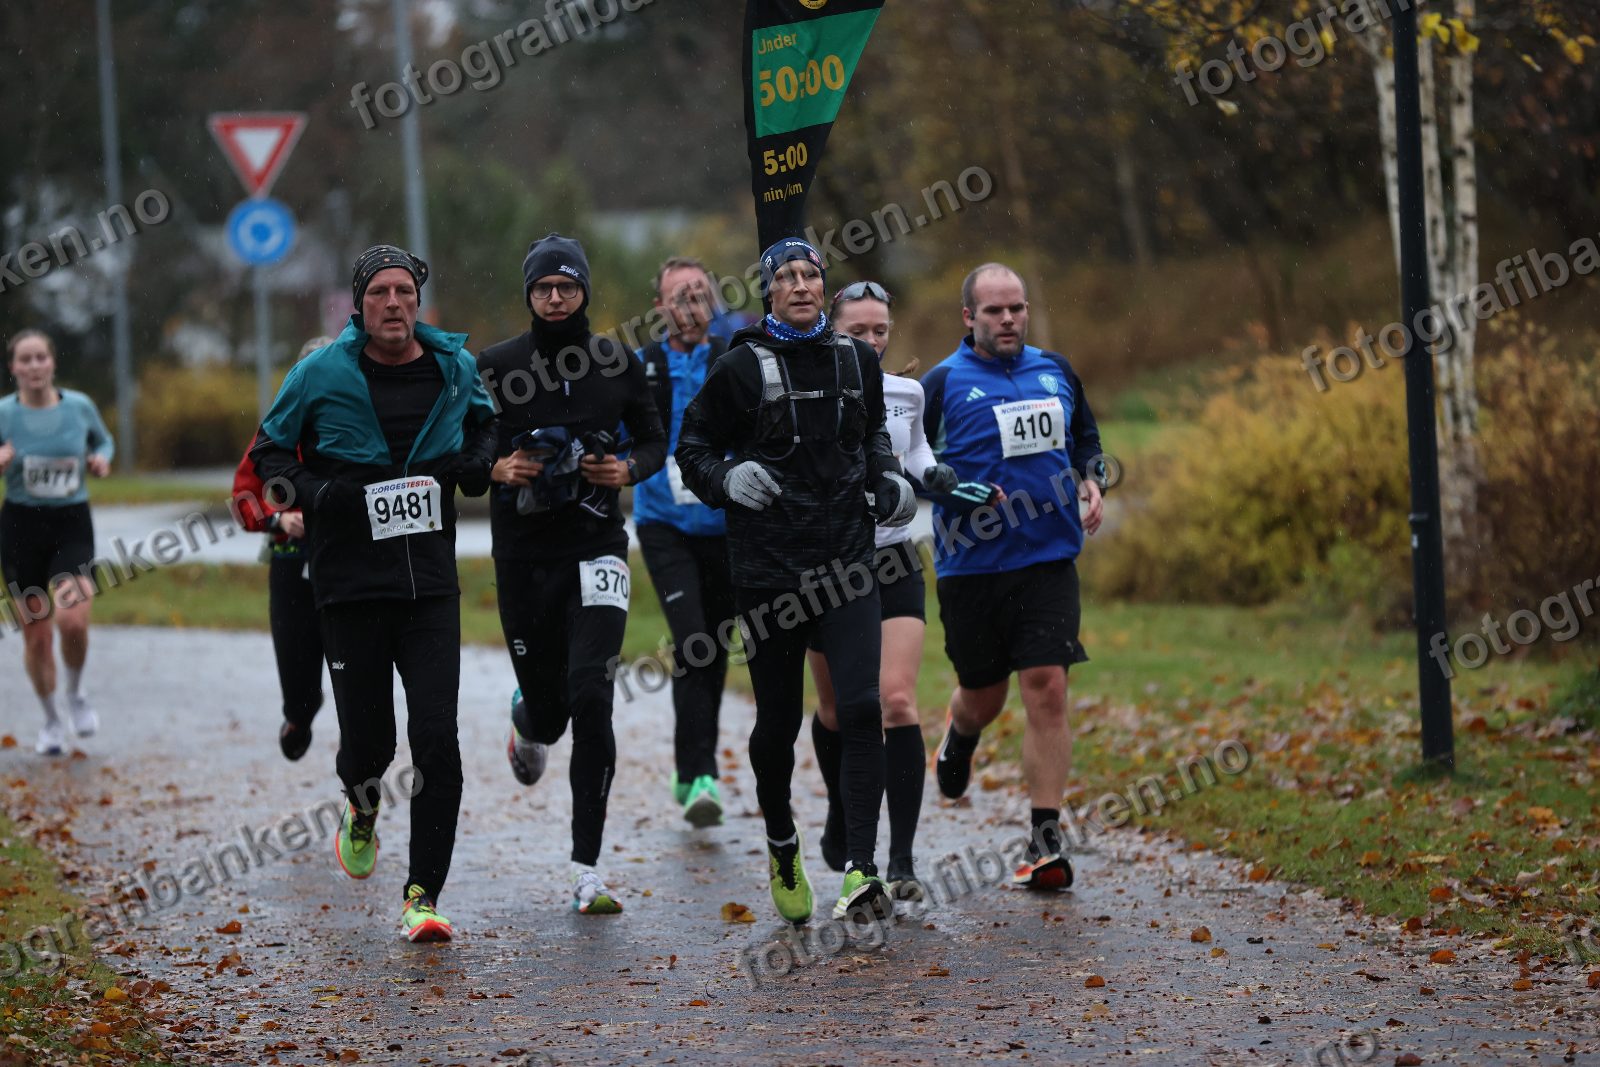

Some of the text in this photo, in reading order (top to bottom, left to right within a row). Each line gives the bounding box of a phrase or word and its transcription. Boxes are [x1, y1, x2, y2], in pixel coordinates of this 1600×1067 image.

[757, 32, 797, 55] Under
[759, 54, 845, 107] 50:00
[763, 142, 808, 176] 5:00
[1013, 411, 1053, 440] 410
[374, 490, 431, 525] 9481
[594, 568, 629, 599] 370
